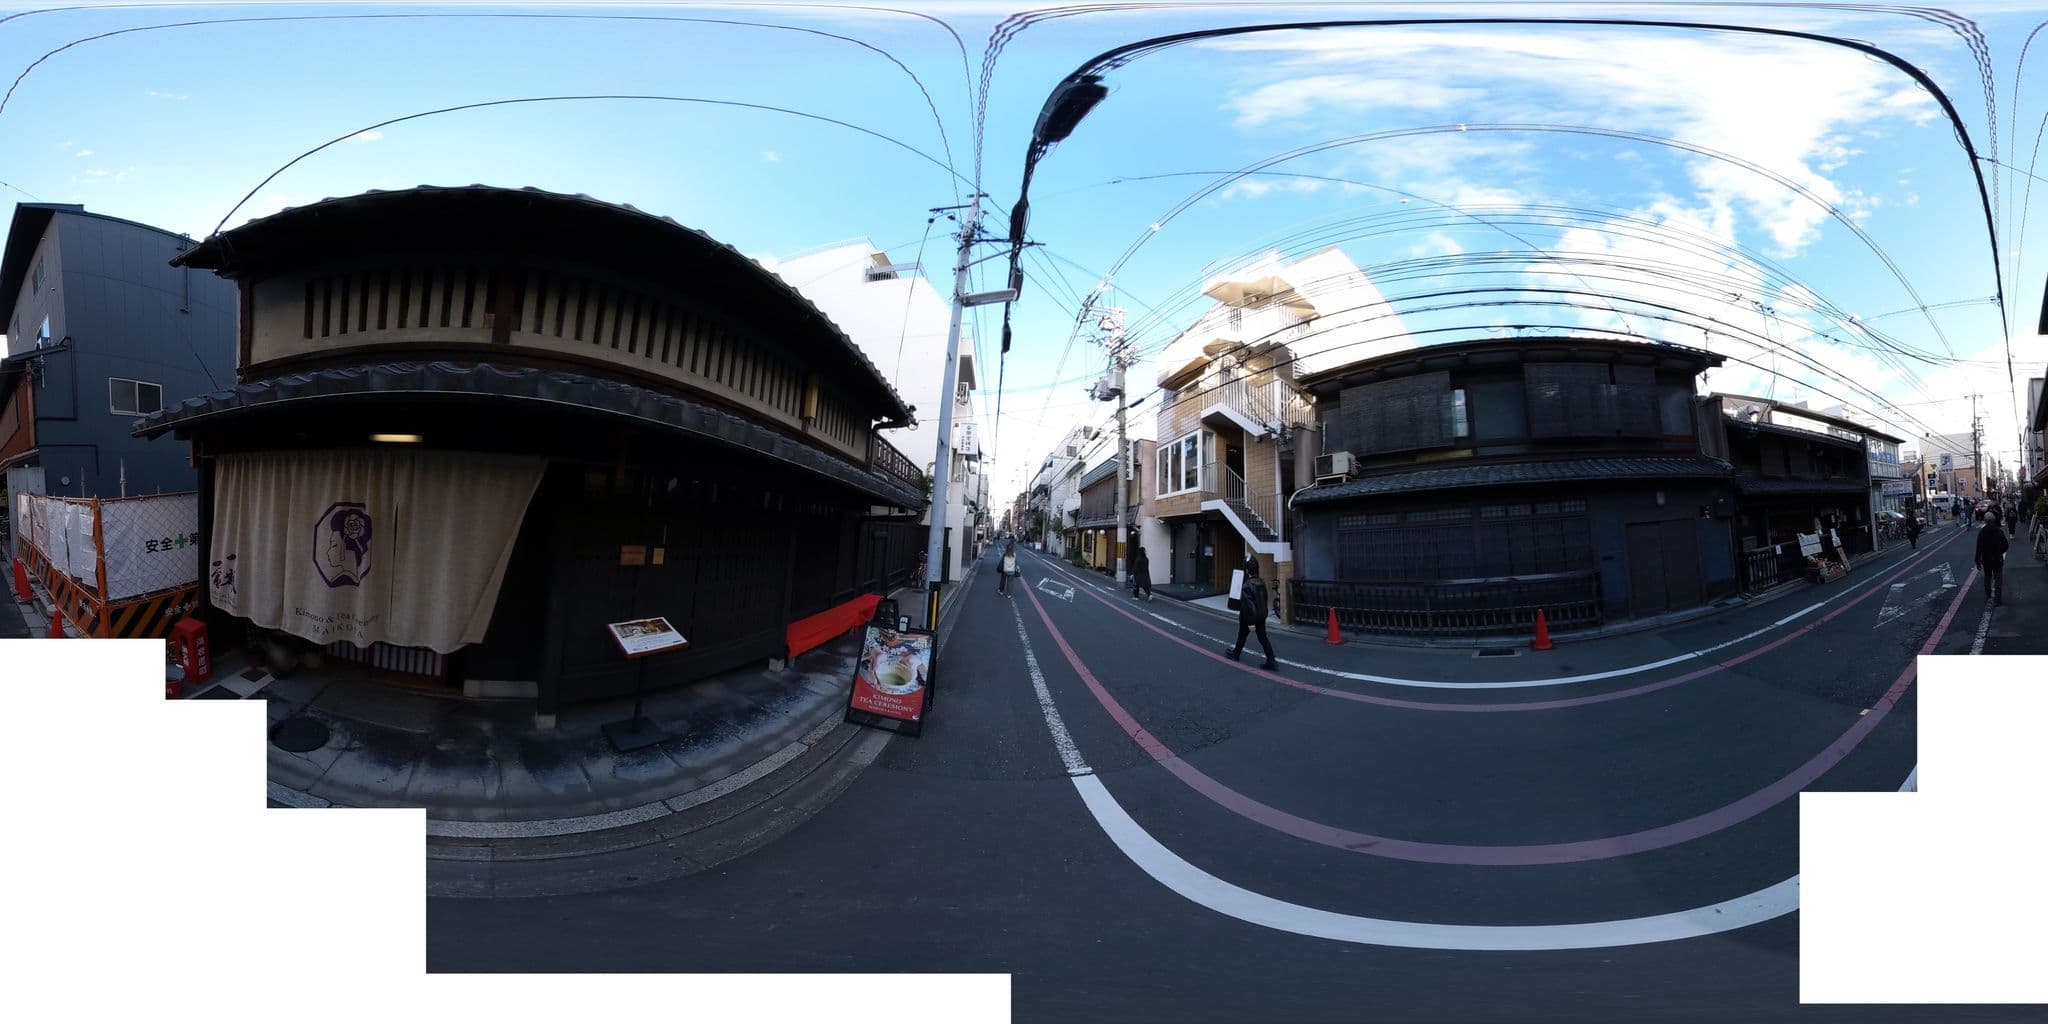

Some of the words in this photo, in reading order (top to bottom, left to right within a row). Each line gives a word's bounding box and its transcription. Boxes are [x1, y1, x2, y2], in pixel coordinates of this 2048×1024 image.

[145, 536, 173, 554] 安全
[326, 615, 334, 624] &
[312, 623, 363, 639] MAIKOA
[860, 696, 873, 705] TEA
[873, 700, 913, 713] CEREMONY
[872, 694, 903, 705] KIMONO
